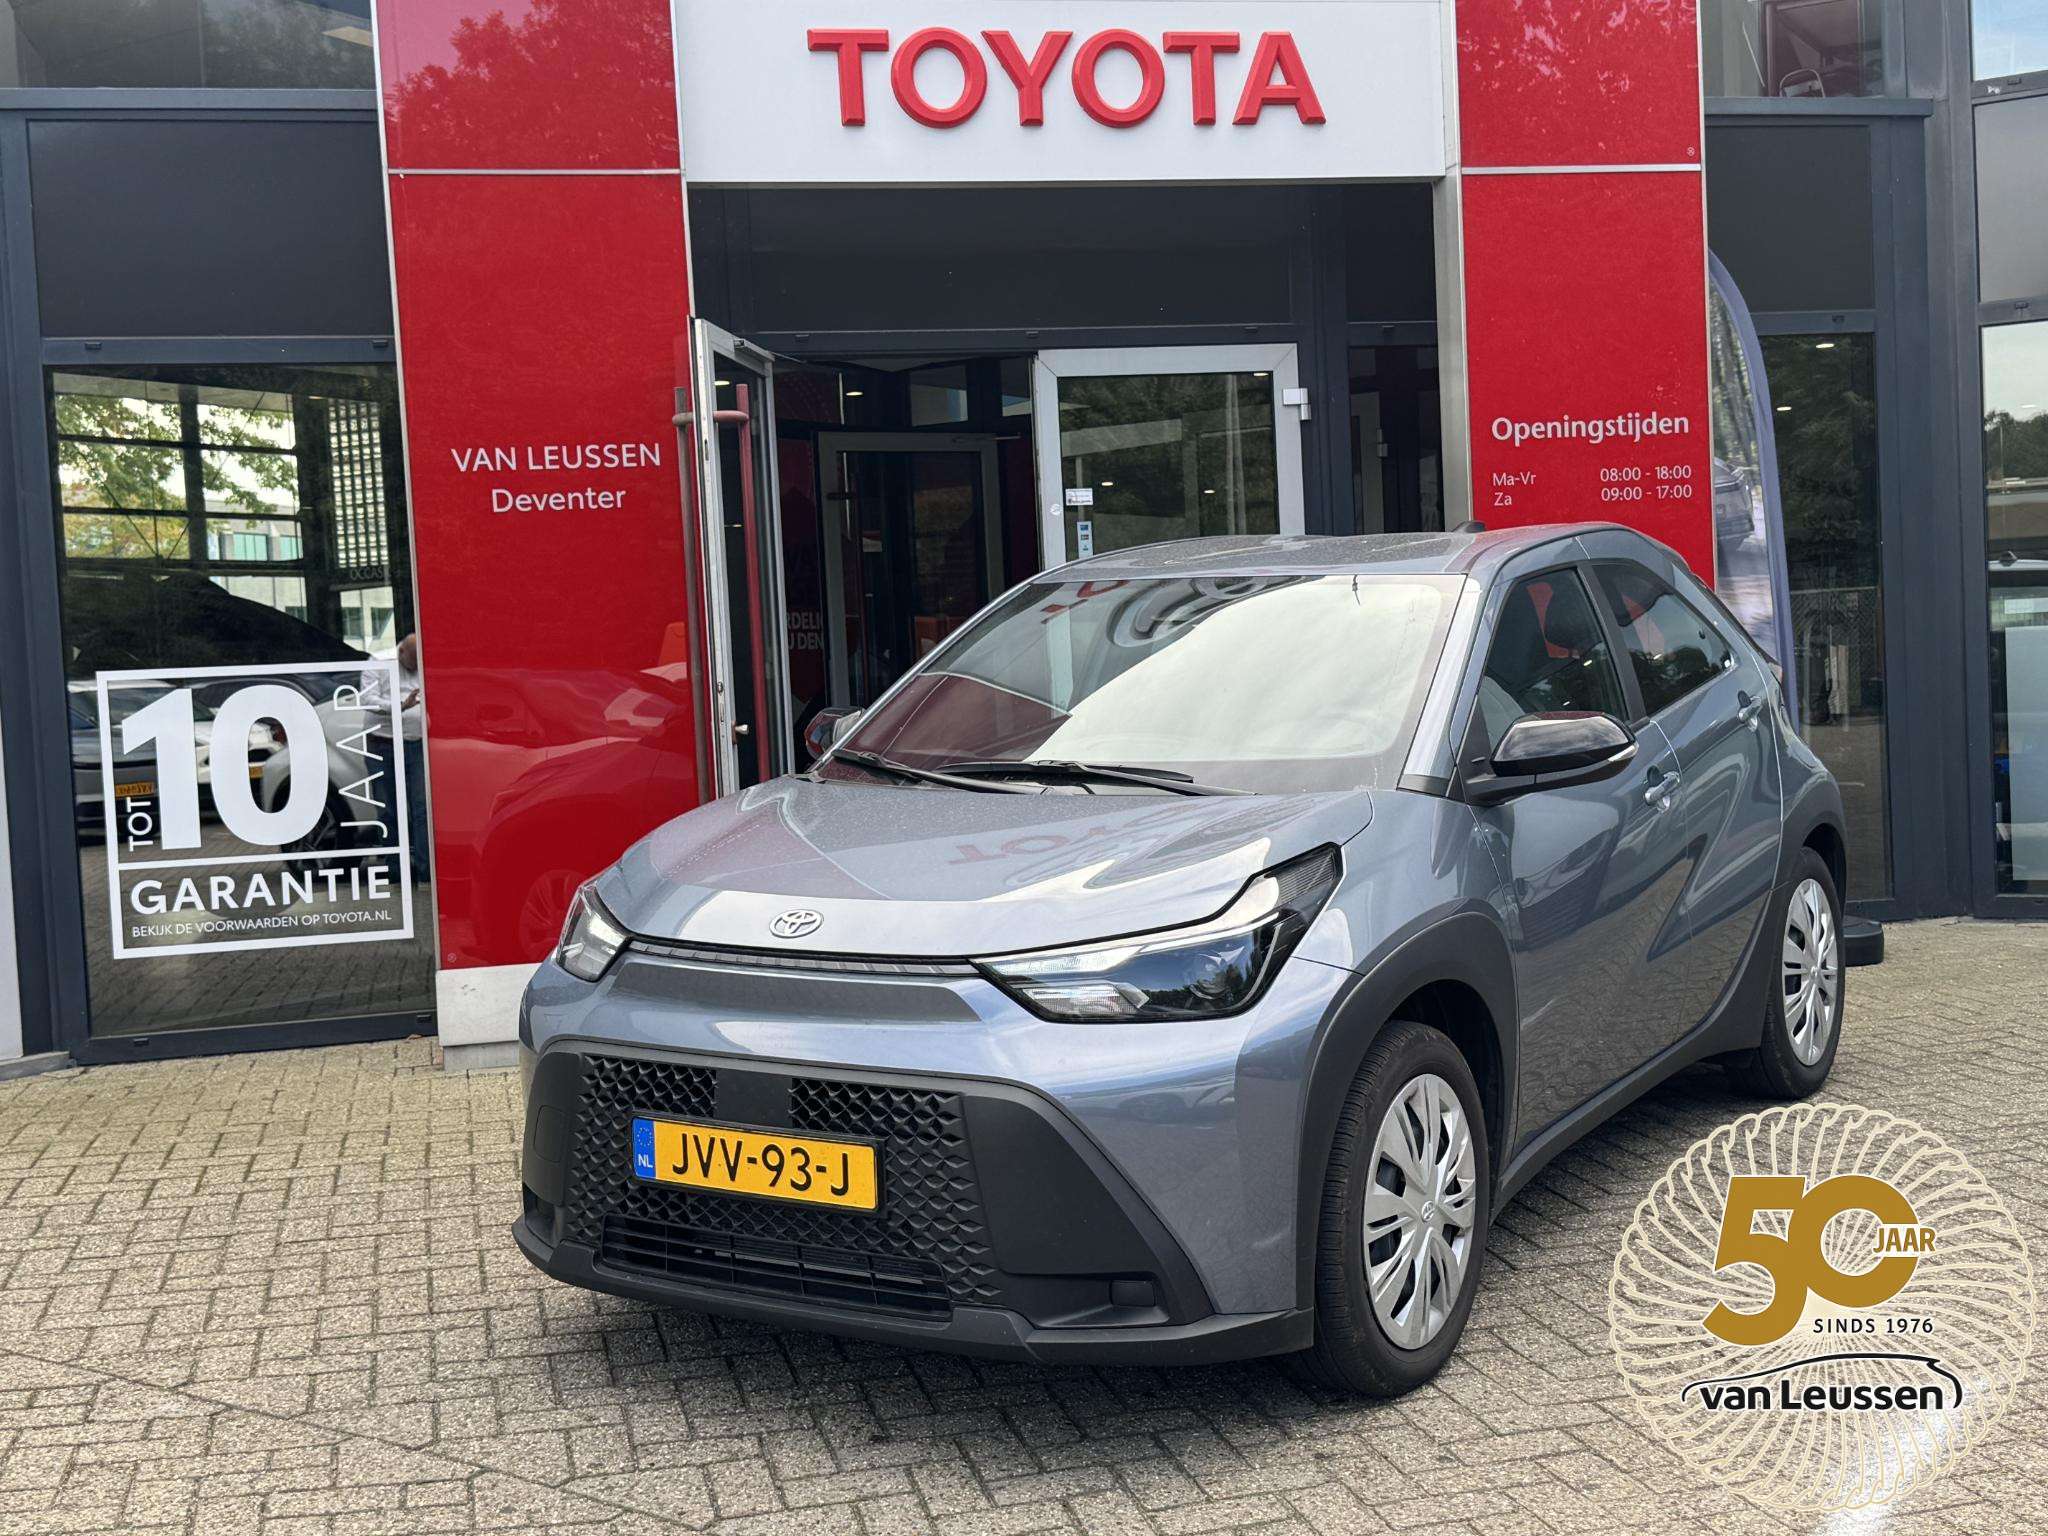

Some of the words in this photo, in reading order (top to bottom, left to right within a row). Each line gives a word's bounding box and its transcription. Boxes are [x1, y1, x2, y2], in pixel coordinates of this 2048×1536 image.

[807, 27, 1326, 129] TOYOTA
[1492, 411, 1689, 447] Openingstijden
[451, 447, 517, 472] VAN
[528, 443, 661, 470] LEUSSEN
[1493, 471, 1536, 486] Ma-Vr
[1600, 467, 1641, 482] 08:00
[1655, 465, 1692, 480] 18:00
[492, 487, 626, 513] Deventer
[1494, 493, 1512, 506] Za
[1601, 486, 1642, 502] 09:00
[1656, 484, 1692, 499] 17:00
[121, 684, 329, 849] 10
[333, 679, 388, 839] JAAR
[126, 796, 154, 852] TOT
[130, 865, 392, 915] GARANTIE
[132, 923, 173, 938] BEKIJK
[176, 921, 193, 934] DE
[198, 915, 298, 933] VOORWAARDEN
[301, 913, 320, 927] OP
[322, 910, 392, 923] TOYOTA.NL
[638, 1153, 653, 1168] NL
[672, 1133, 849, 1196] JVV-93-J
